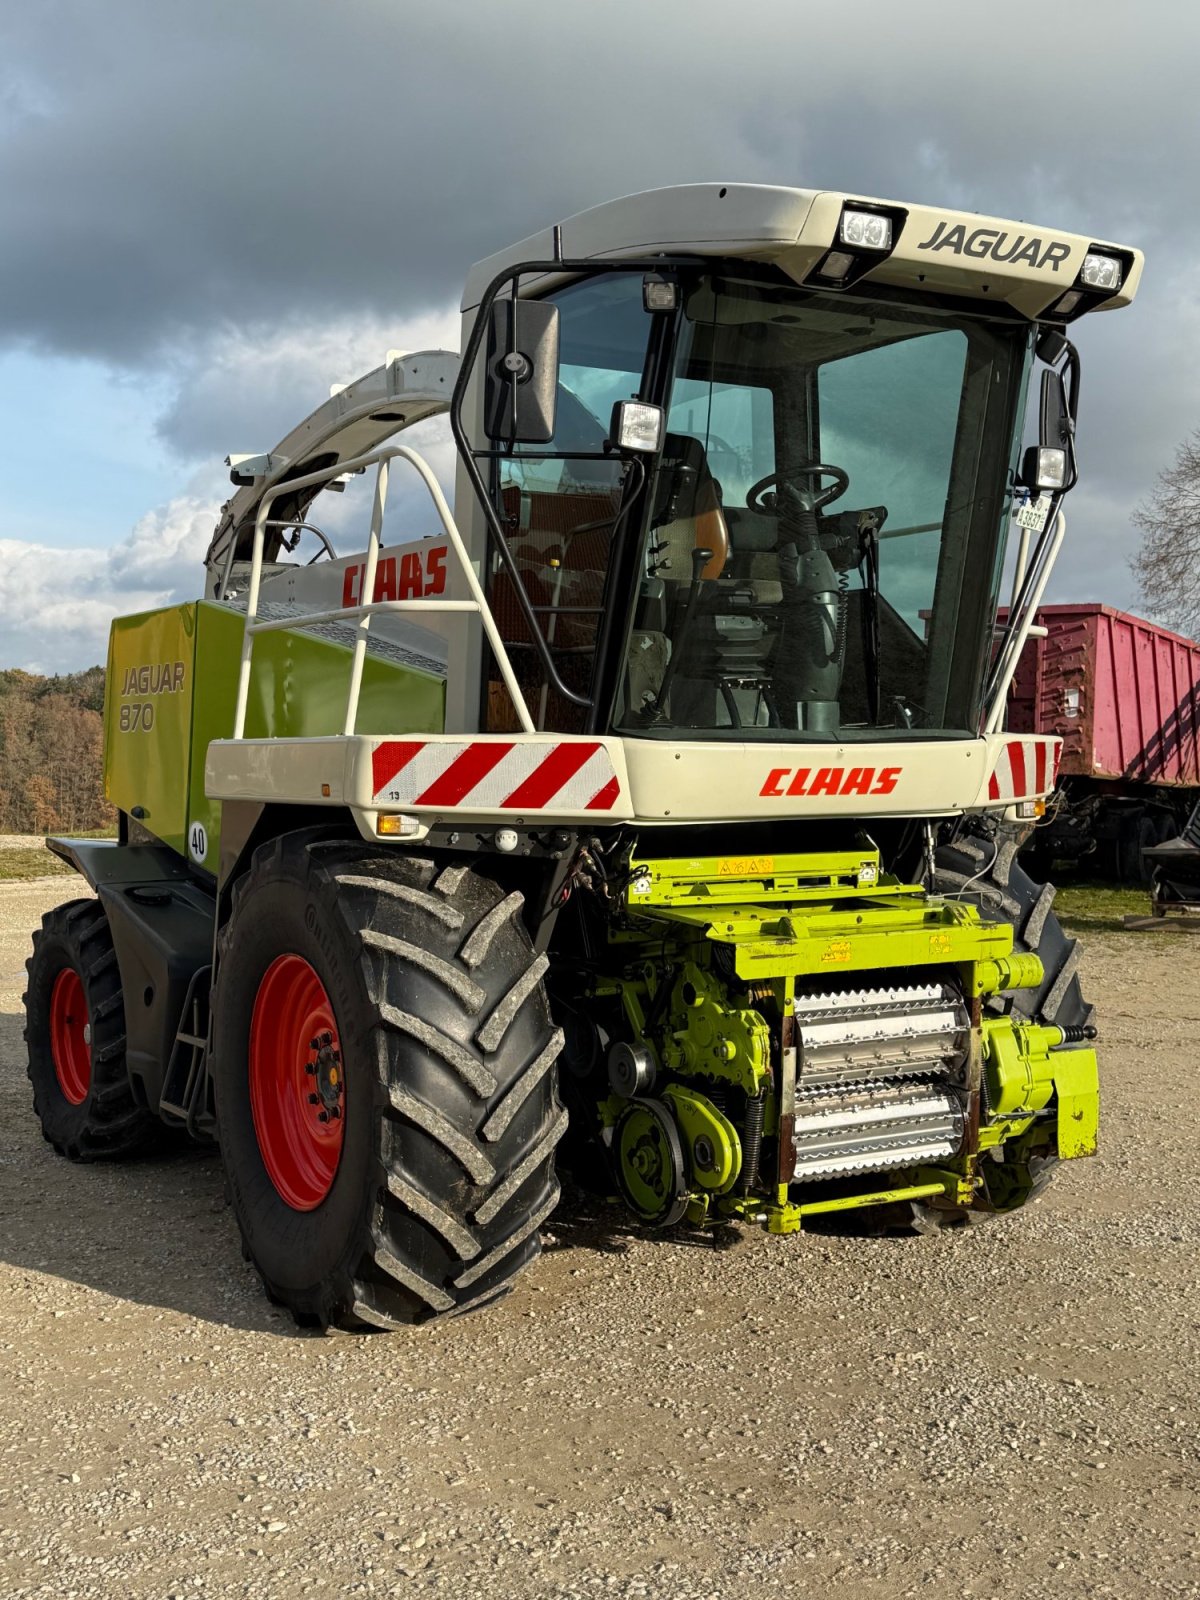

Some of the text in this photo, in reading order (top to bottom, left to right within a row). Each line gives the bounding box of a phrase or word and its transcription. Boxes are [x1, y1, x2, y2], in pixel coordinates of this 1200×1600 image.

[917, 221, 1071, 272] JAGUAR
[121, 661, 185, 697] JAGUAR
[119, 703, 154, 733] 870
[759, 767, 903, 797] CLAAS
[191, 827, 205, 855] 40
